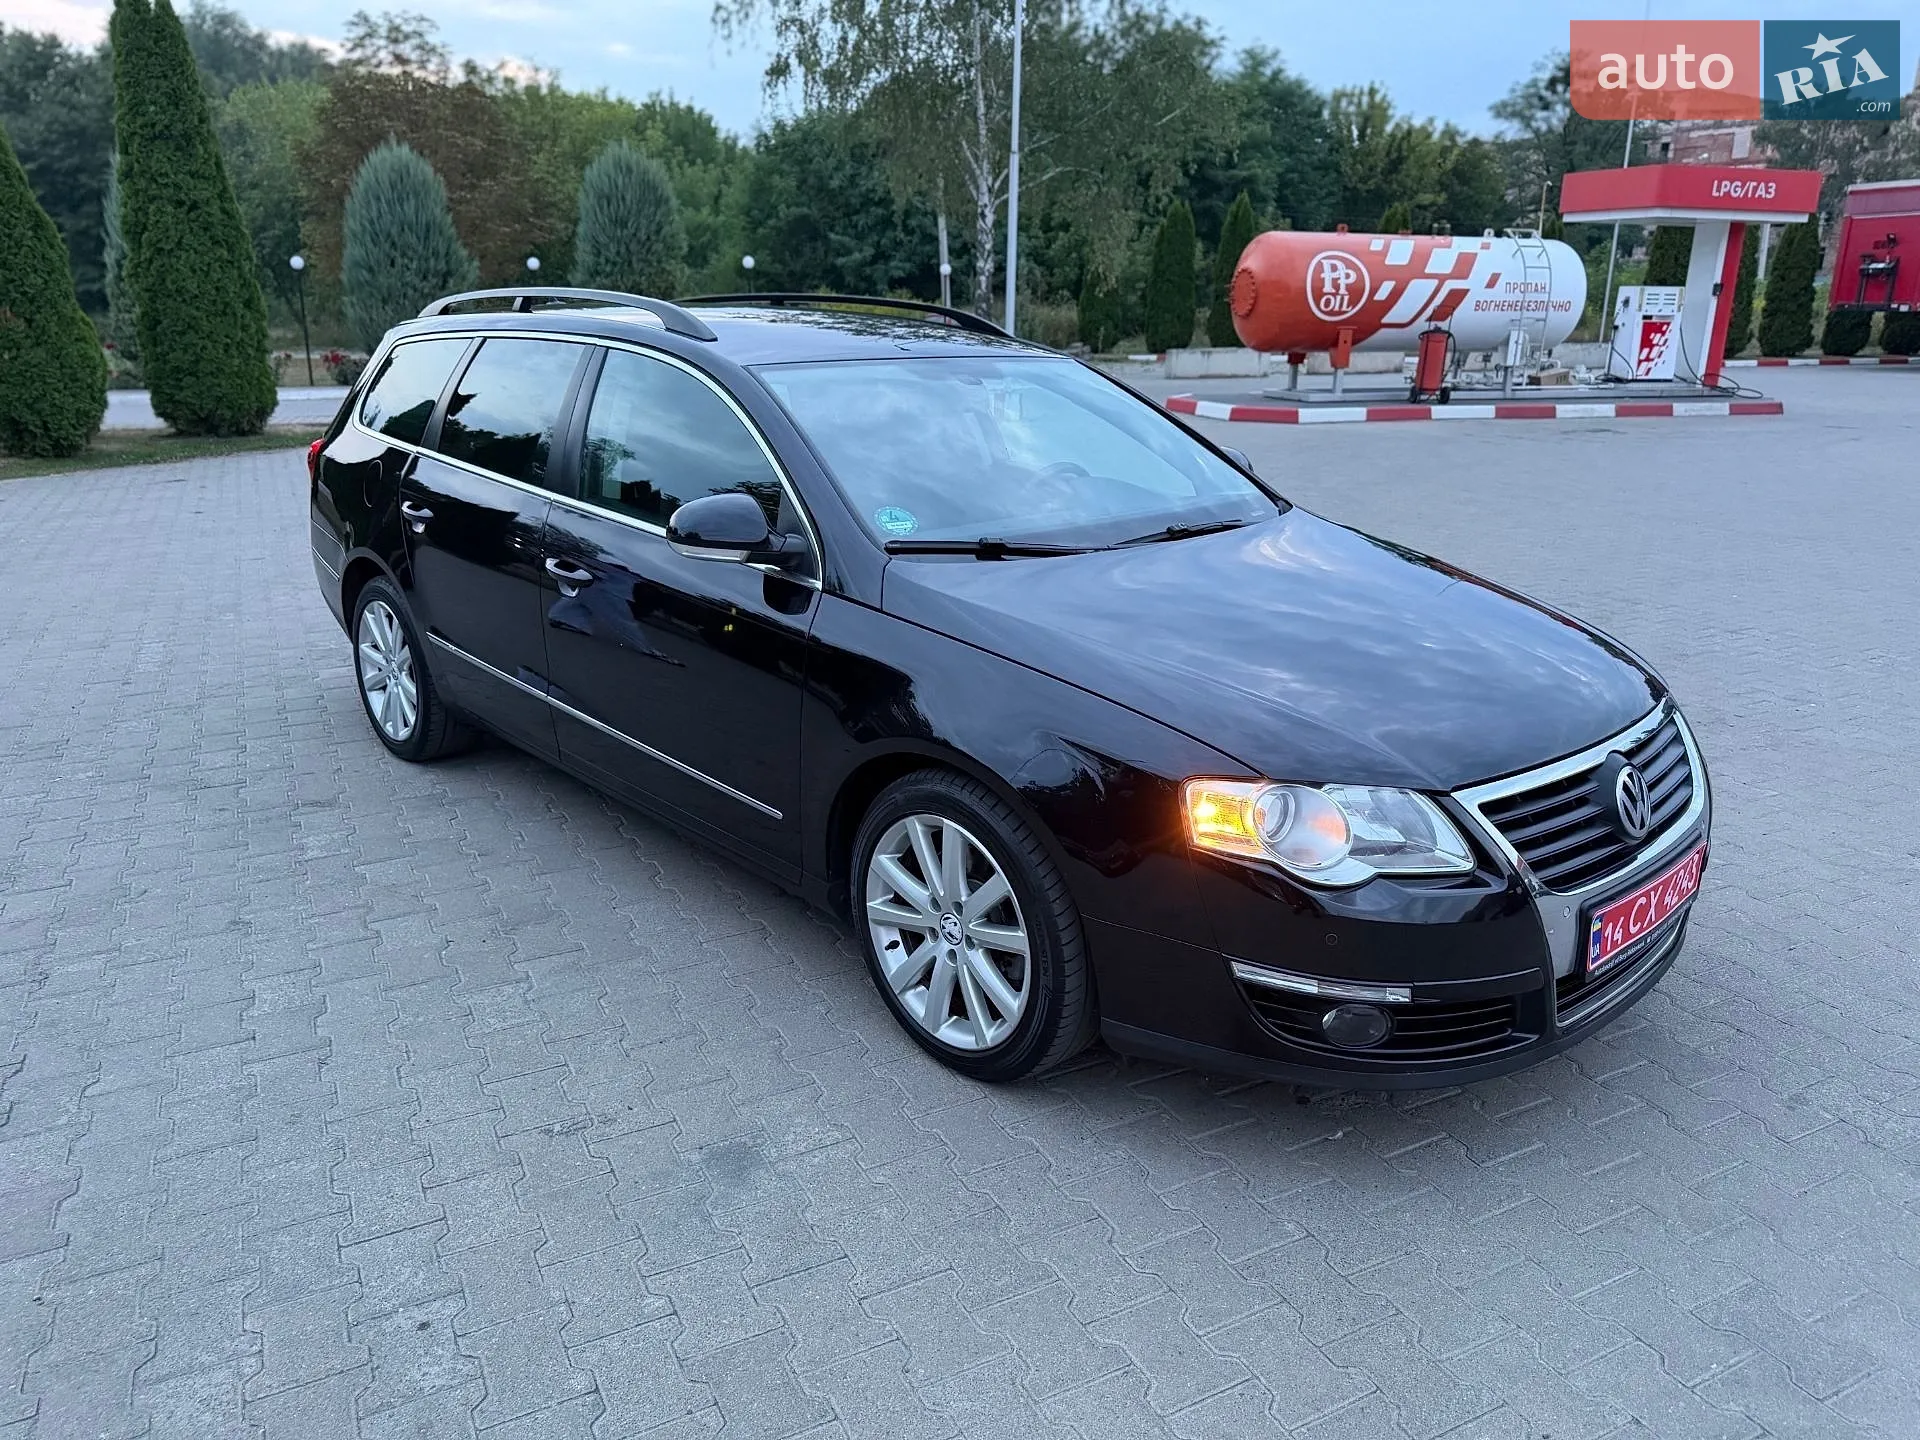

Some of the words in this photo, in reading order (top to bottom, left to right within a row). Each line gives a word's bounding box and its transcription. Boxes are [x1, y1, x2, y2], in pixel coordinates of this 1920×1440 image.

[1711, 179, 1776, 199] LPG/ГАЗ
[1505, 281, 1547, 294] ПРОПАН
[1320, 294, 1353, 312] OIL
[1604, 916, 1625, 953] 14
[1629, 885, 1664, 935] CX
